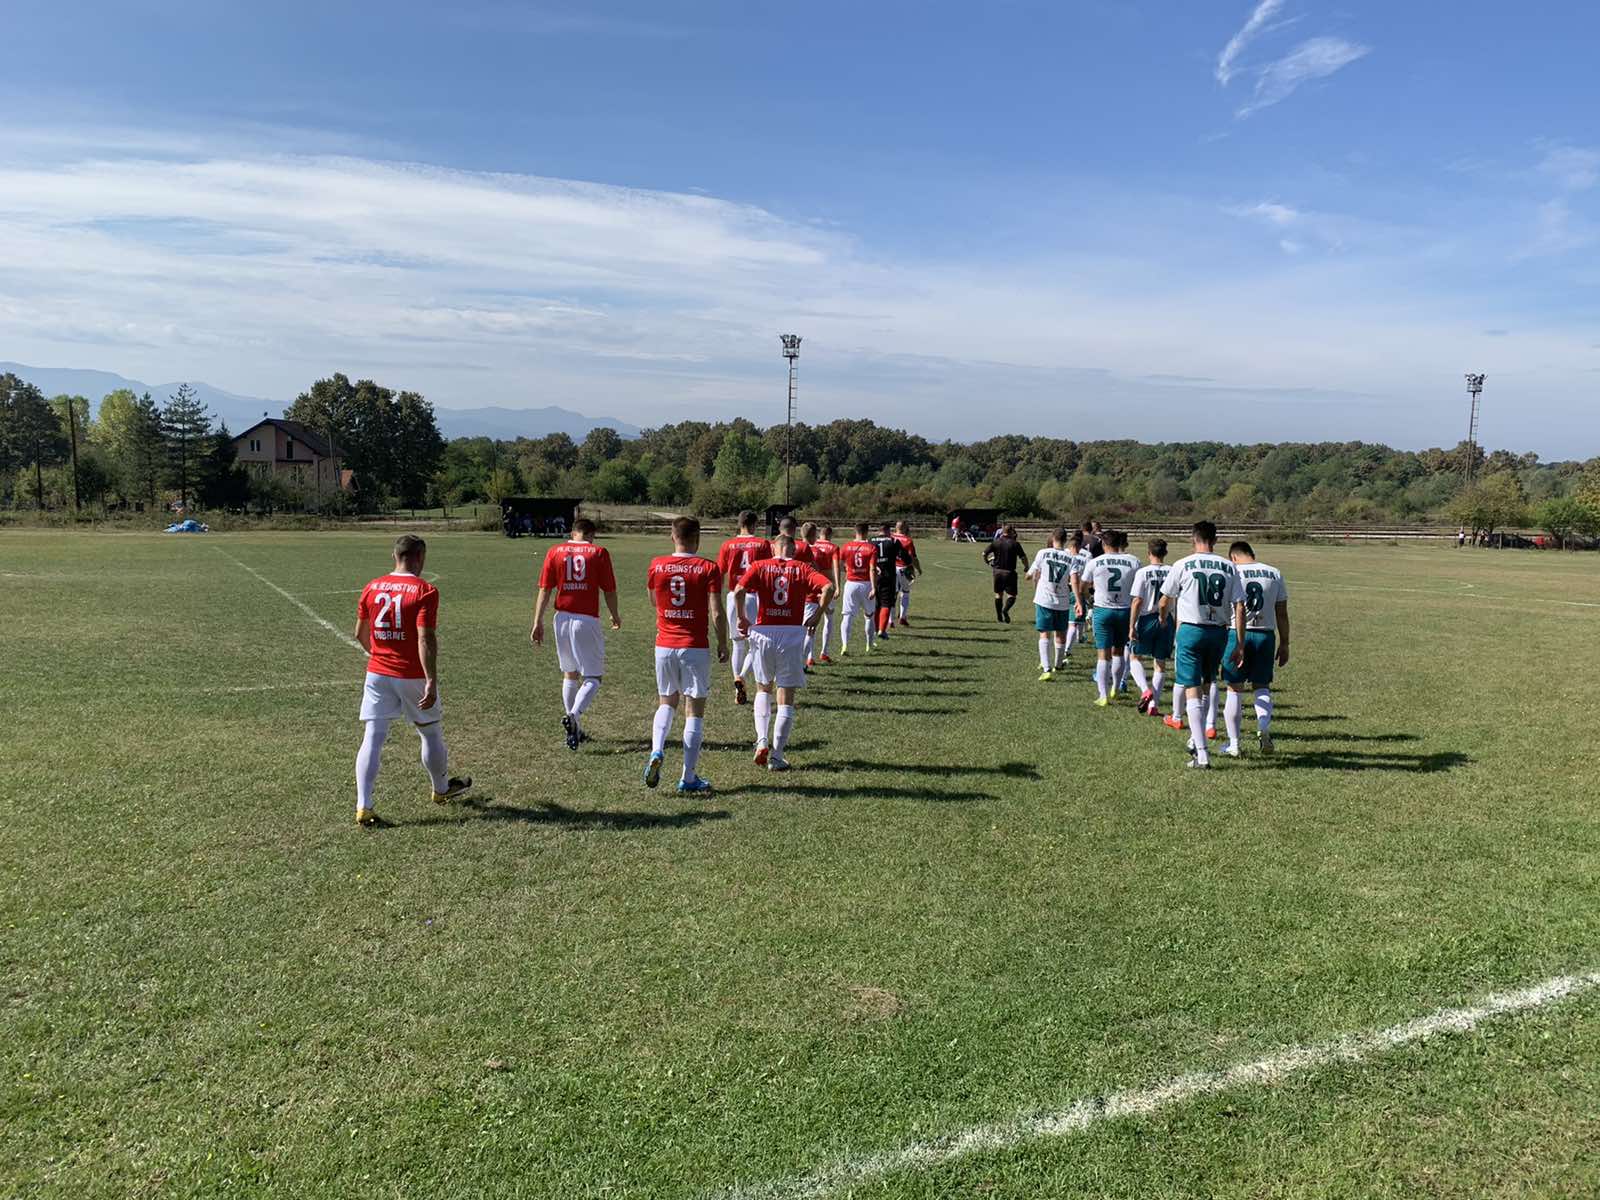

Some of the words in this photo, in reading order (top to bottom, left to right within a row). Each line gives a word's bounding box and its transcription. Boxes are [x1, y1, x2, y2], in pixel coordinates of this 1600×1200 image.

[563, 555, 586, 582] 19
[740, 551, 752, 572] 4
[854, 552, 862, 568] 6
[1046, 560, 1068, 583] 17
[1184, 560, 1196, 571] FK
[670, 575, 686, 606] 9
[773, 576, 788, 605] 8
[1108, 568, 1122, 592] 2
[1192, 572, 1226, 607] 18
[374, 590, 402, 628] 21
[1246, 582, 1264, 611] 8
